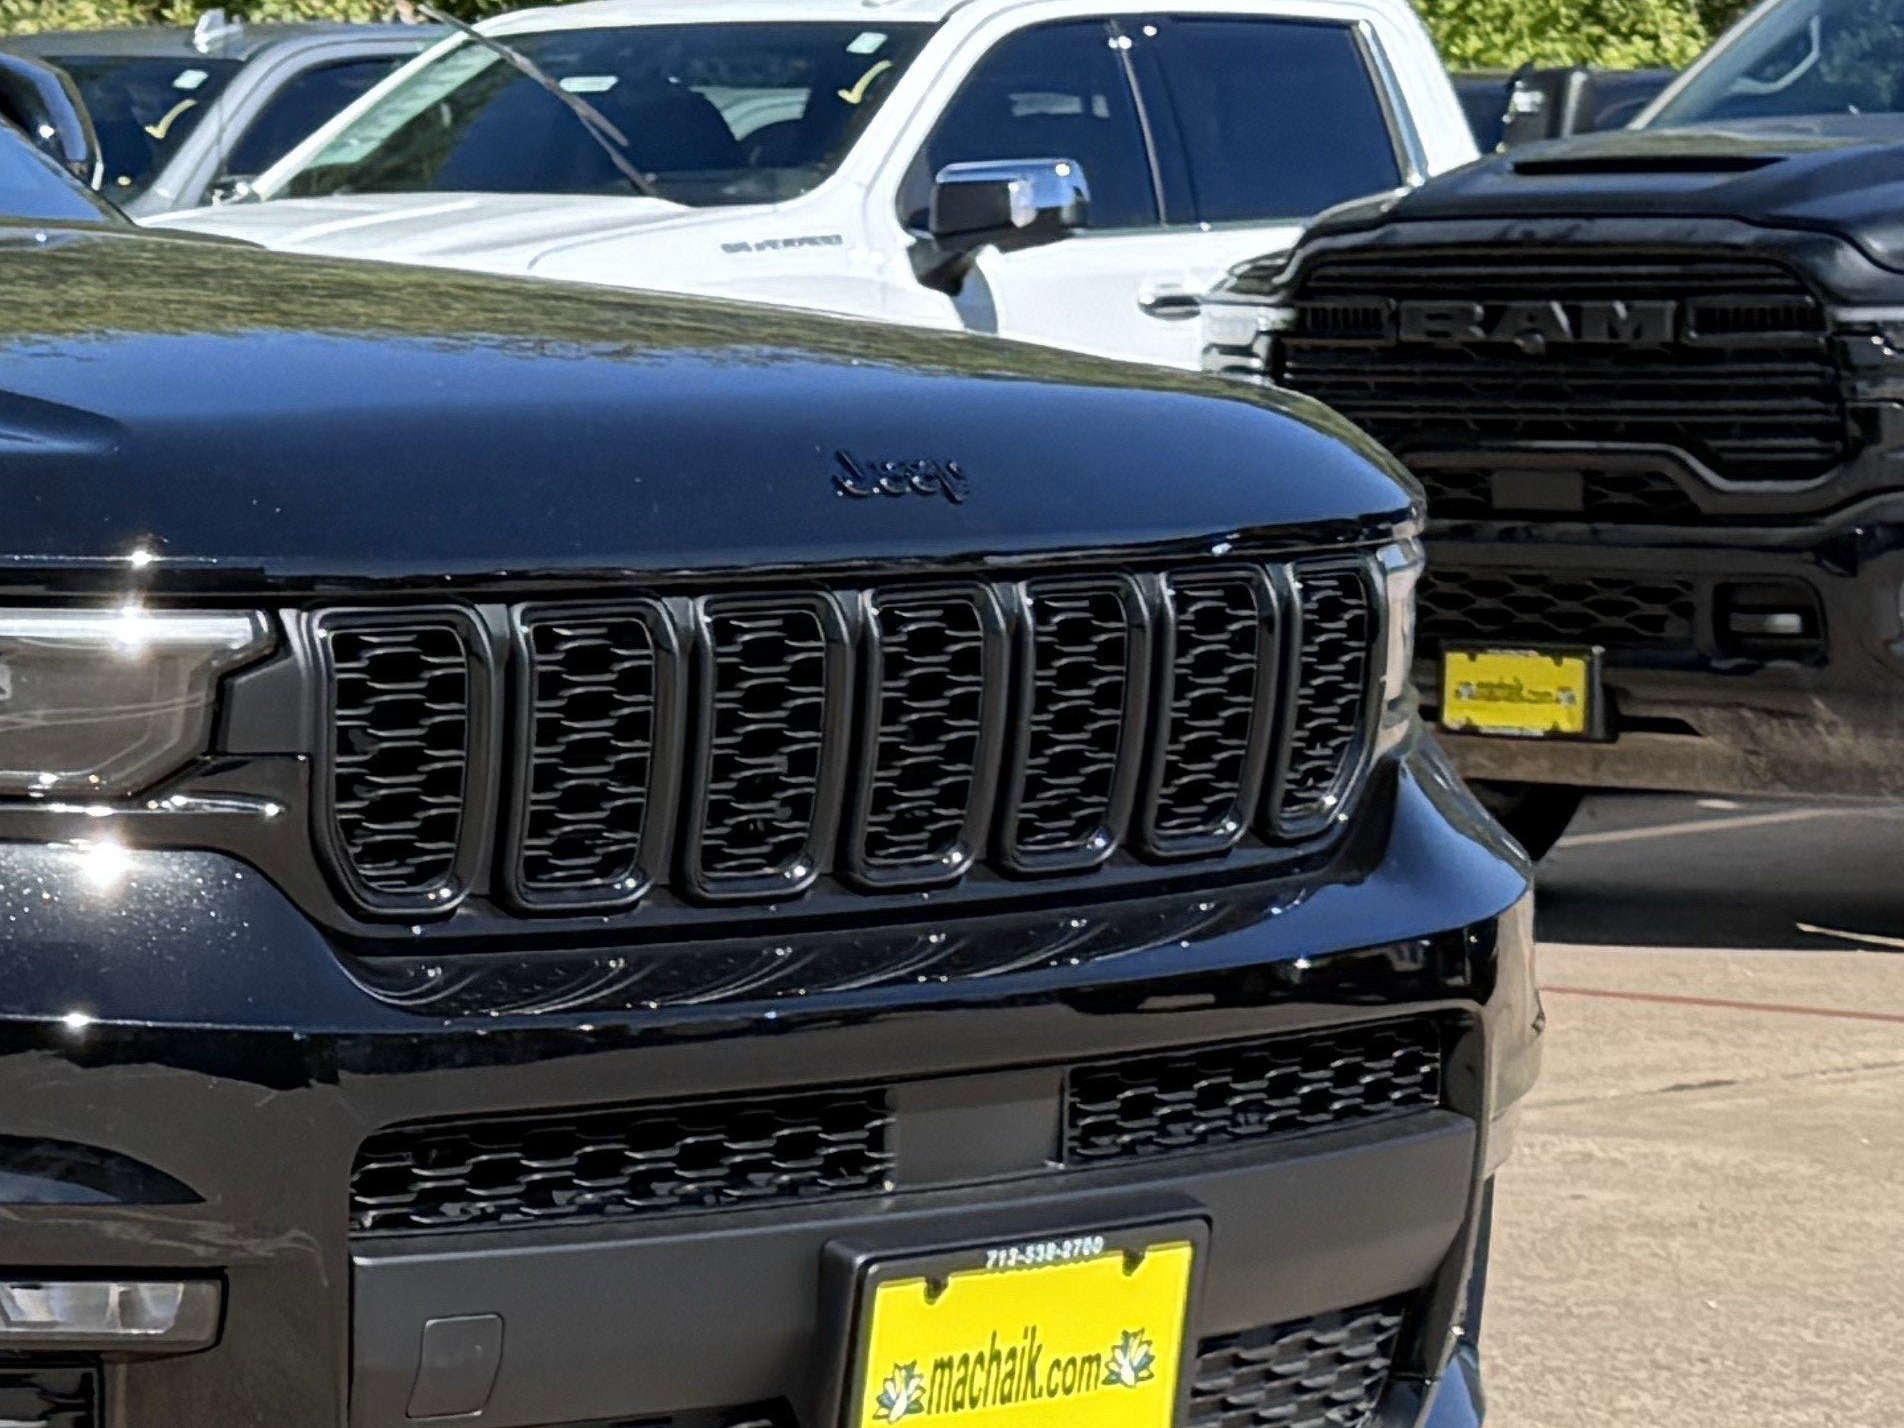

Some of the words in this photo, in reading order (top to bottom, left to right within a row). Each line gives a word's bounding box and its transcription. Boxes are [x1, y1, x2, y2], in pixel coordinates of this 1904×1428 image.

[1398, 299, 1677, 343] RAM
[831, 449, 970, 504] Jeep
[926, 1324, 1102, 1415] machaik.com
